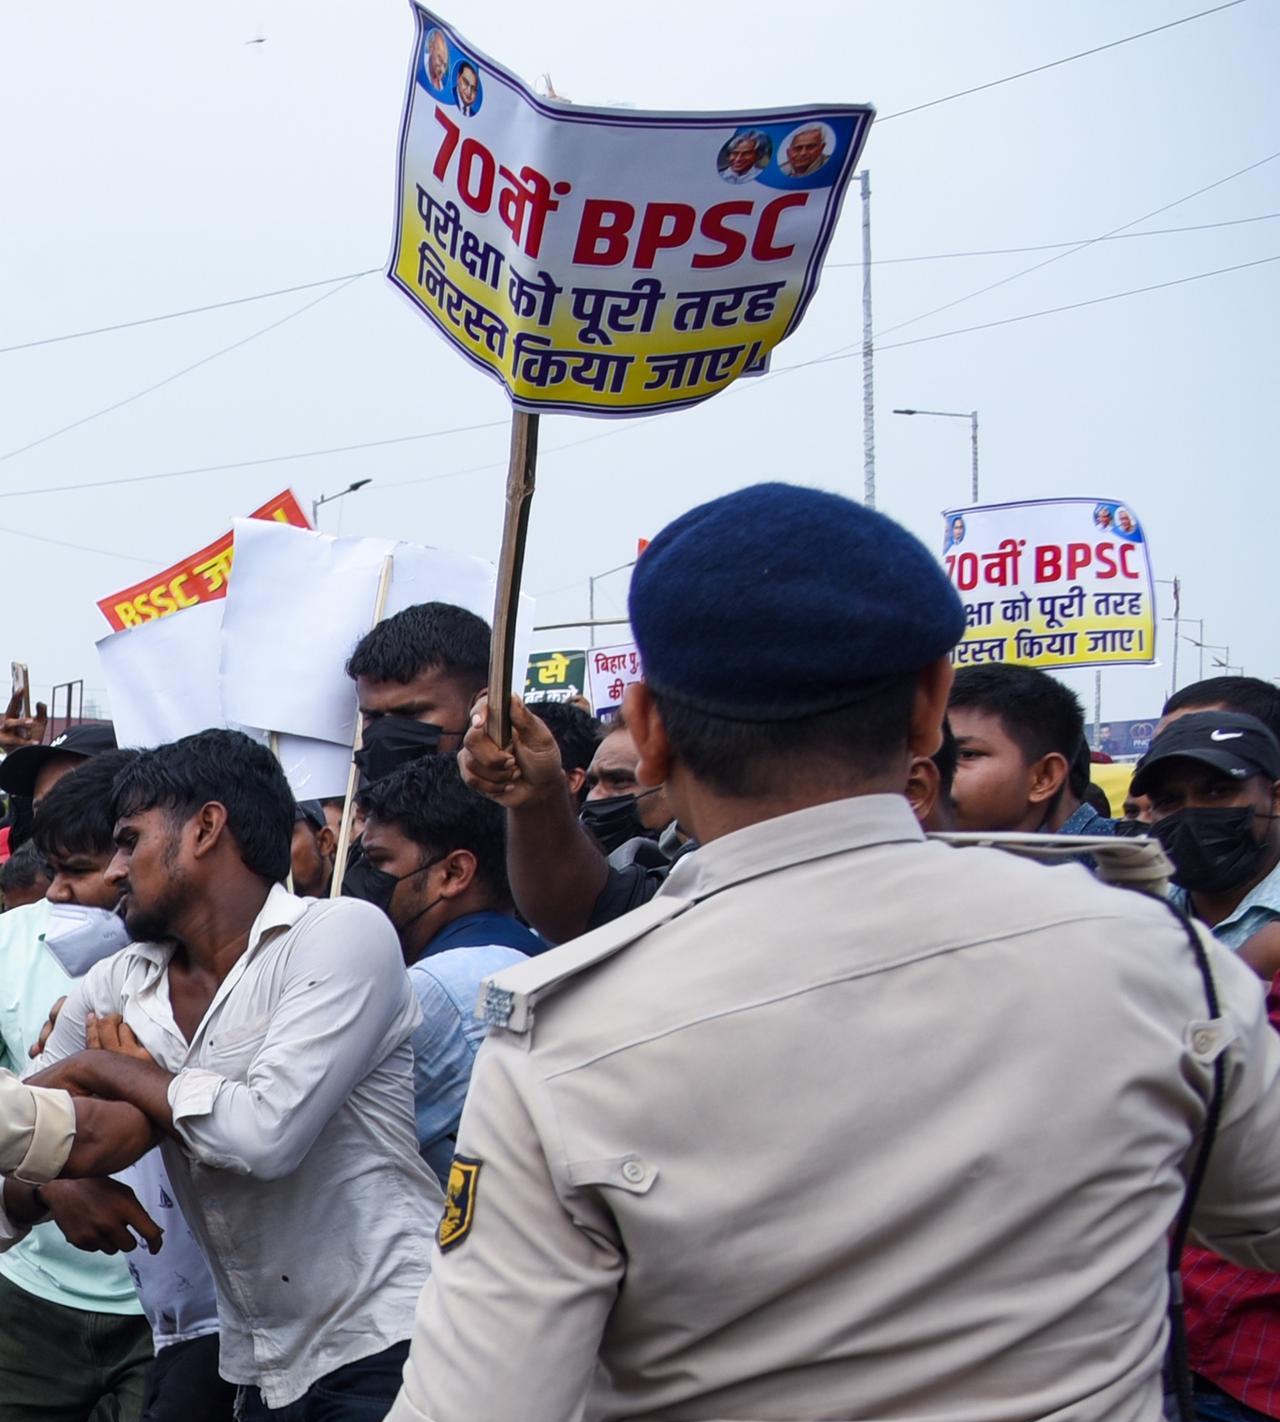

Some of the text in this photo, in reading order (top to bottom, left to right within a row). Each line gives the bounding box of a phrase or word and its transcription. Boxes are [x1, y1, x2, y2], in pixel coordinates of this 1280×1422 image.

[432, 106, 810, 270] 70वीं BPSC
[415, 182, 786, 346] परीक्षा को पूरी तरह
[417, 245, 508, 360] निरस्त
[511, 332, 635, 394] किया
[1034, 542, 1140, 585] BPSC
[114, 573, 200, 630] BSSC
[1002, 591, 1031, 623] को
[1039, 585, 1087, 629] पूरी
[1093, 592, 1142, 617] तरह
[594, 652, 627, 674] बिहार
[1014, 629, 1079, 659] किया
